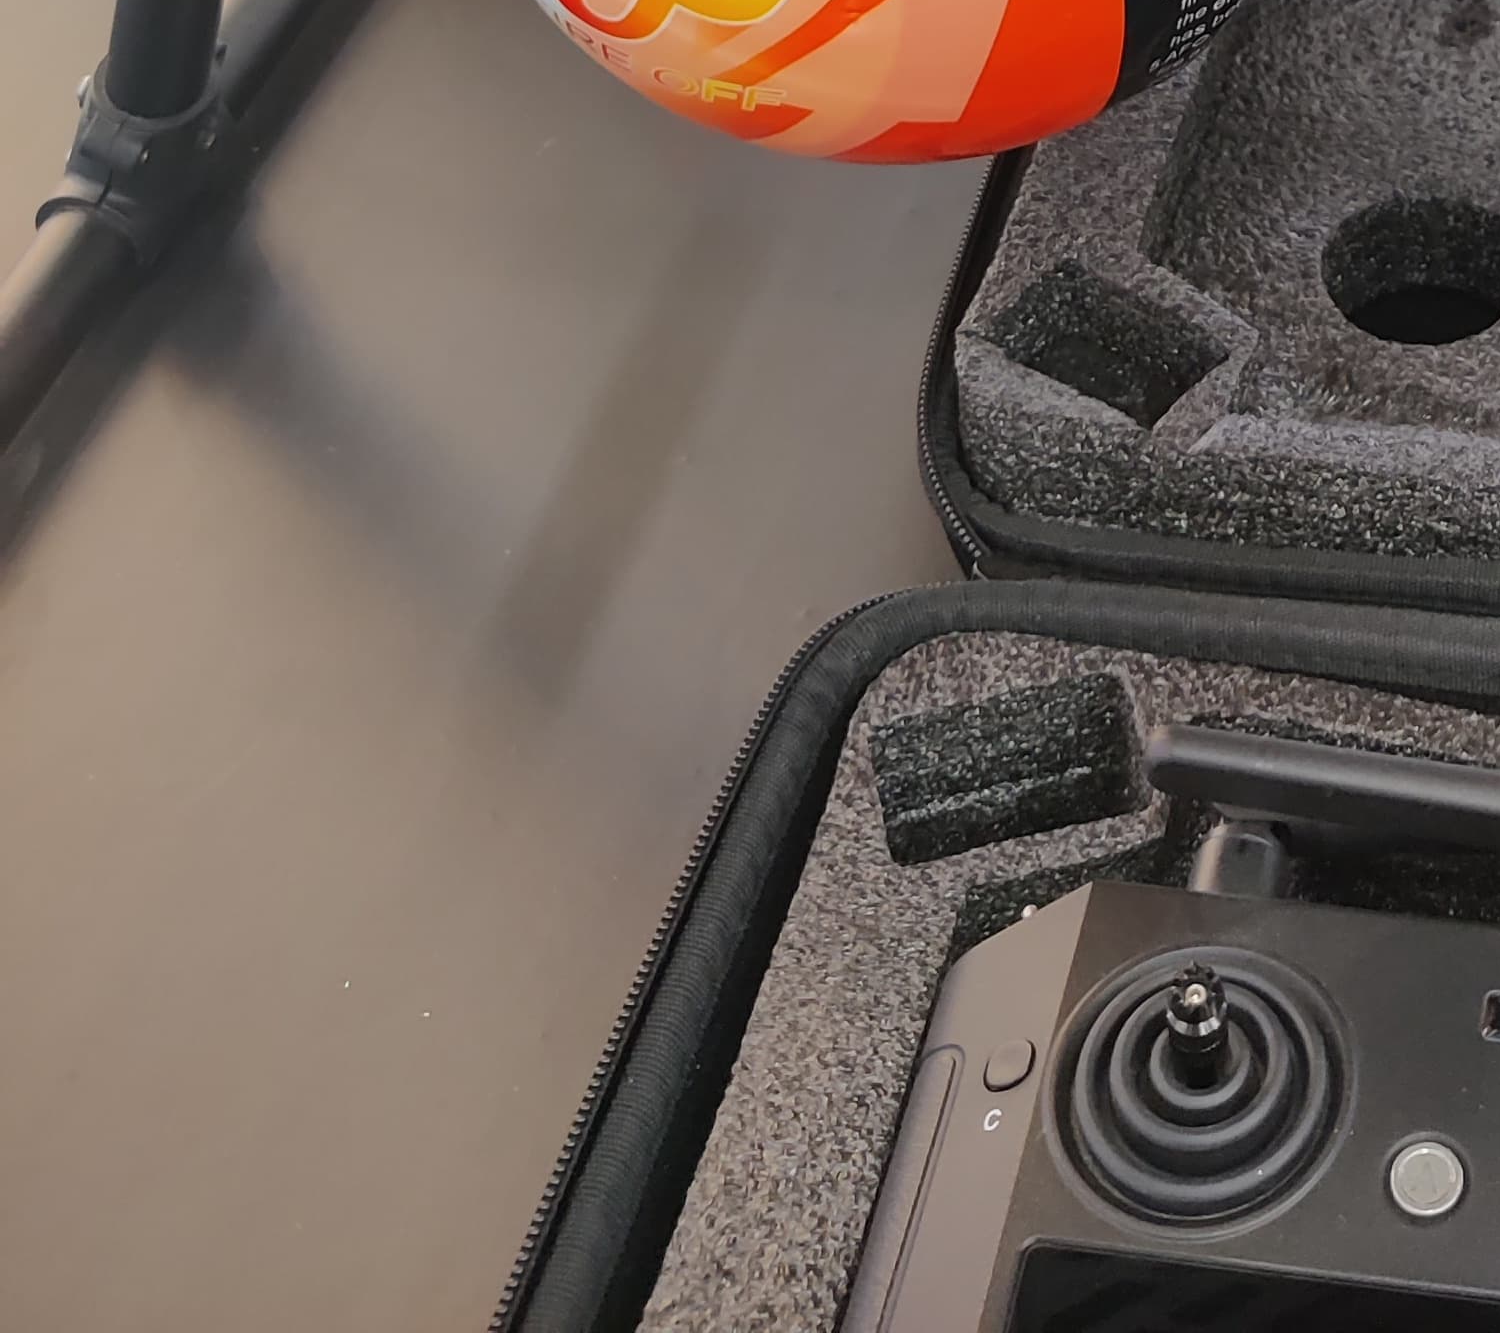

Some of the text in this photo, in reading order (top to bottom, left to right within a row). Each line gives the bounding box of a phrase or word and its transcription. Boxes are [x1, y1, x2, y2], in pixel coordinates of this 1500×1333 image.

[1176, 5, 1208, 30] the
[652, 66, 788, 112] OFF
[984, 1108, 1002, 1131] C
